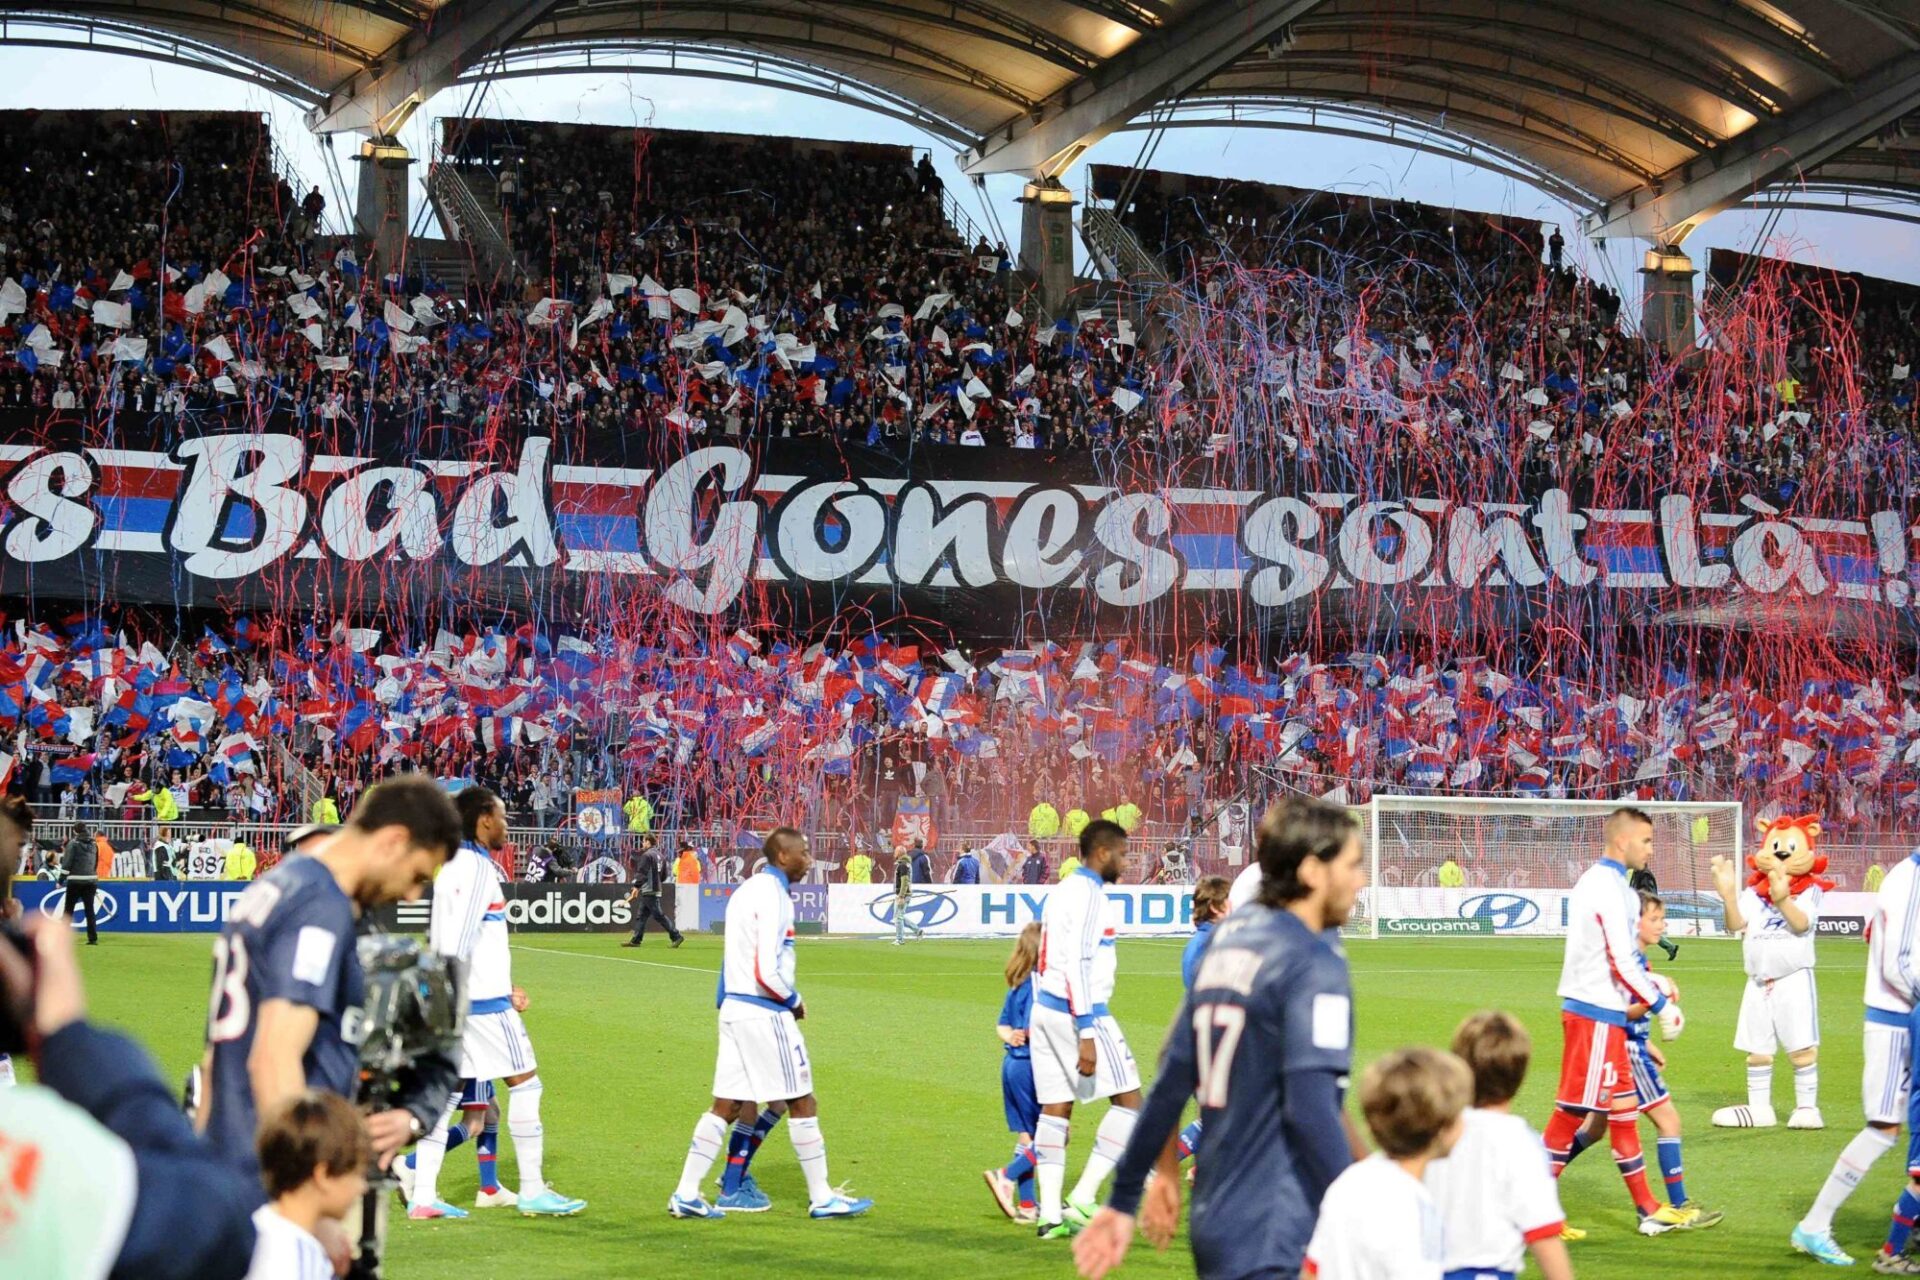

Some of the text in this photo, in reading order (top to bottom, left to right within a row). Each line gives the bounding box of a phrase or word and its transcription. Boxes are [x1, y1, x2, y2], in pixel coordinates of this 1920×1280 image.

[168, 433, 560, 580] Bad
[644, 446, 1179, 614] Gones
[1245, 488, 1597, 607] sont
[1661, 493, 1829, 597] Là
[506, 892, 632, 924] adidas
[1387, 919, 1480, 933] Groupama
[1192, 1003, 1246, 1108] 17
